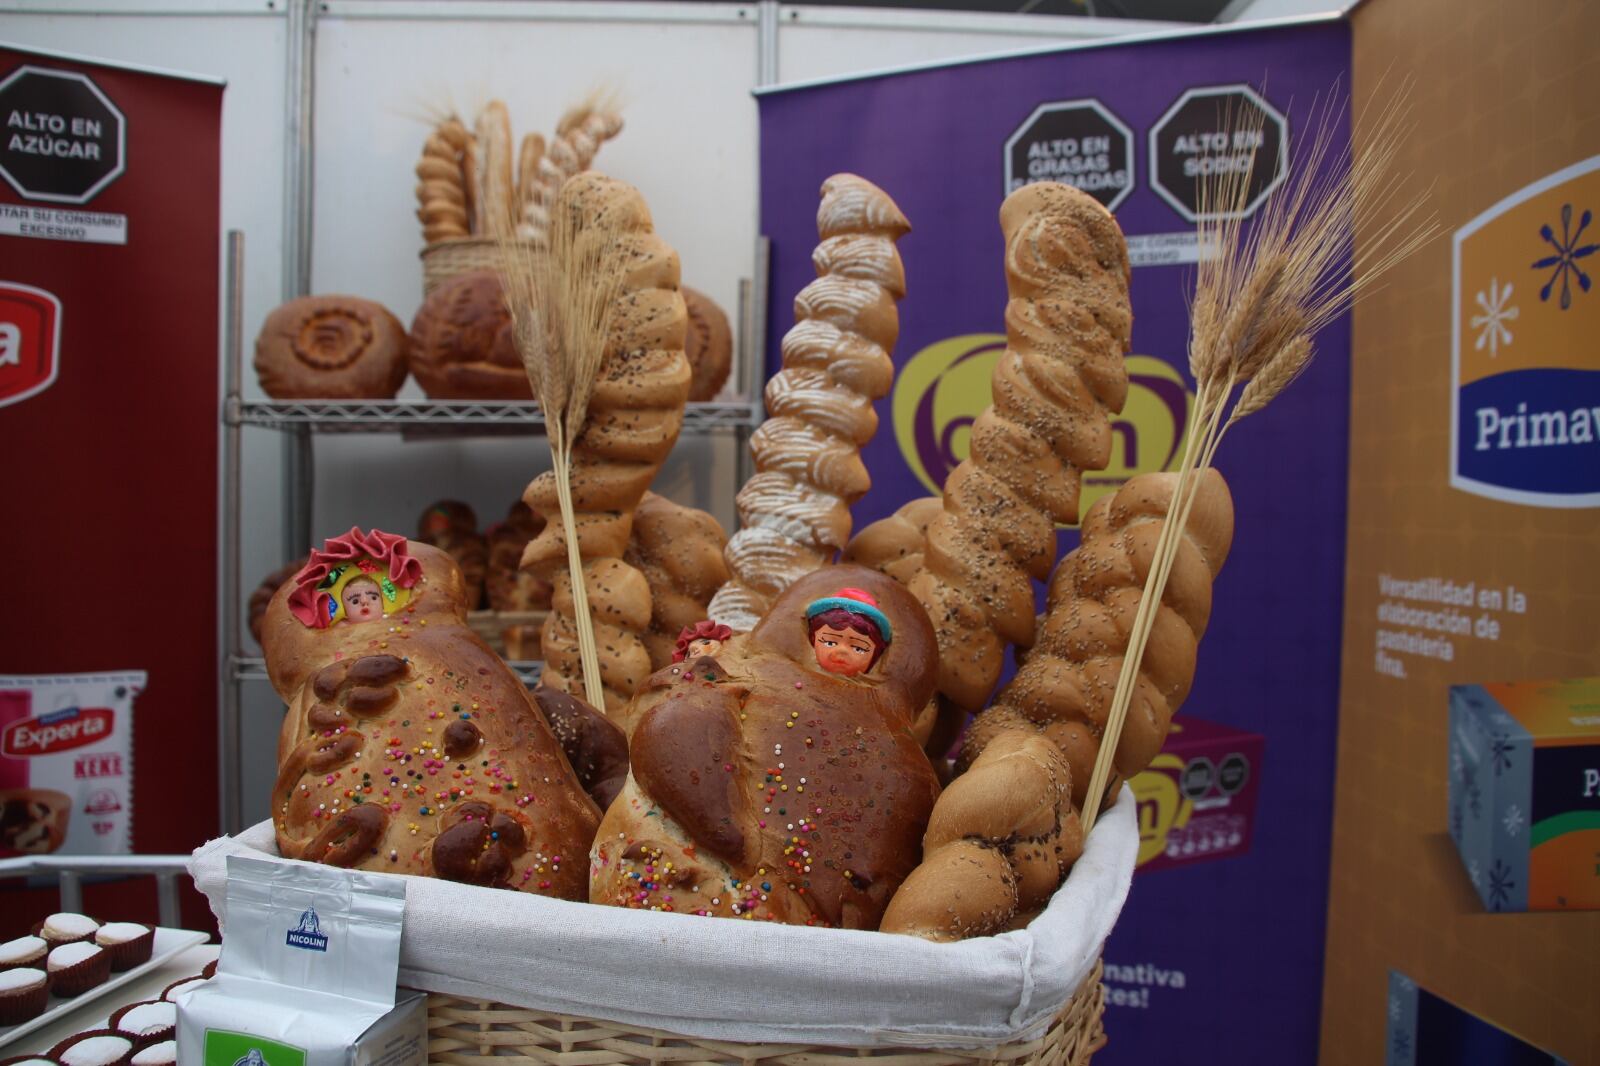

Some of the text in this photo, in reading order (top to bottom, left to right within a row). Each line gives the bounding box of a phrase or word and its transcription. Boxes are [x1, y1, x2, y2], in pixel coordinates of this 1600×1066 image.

[7, 109, 101, 136] ALTO EN
[8, 133, 100, 159] AZÚCAR
[1028, 135, 1110, 159] ALTO EN
[1173, 132, 1229, 154] ALTO
[1028, 153, 1110, 177] GRASAS
[33, 208, 51, 222] SU
[55, 211, 122, 228] CONSUMO
[20, 223, 86, 239] EXCESIVO
[1379, 574, 1527, 614] Versatilidad en la
[1378, 601, 1500, 640] elaboración de
[13, 716, 105, 749] Experta
[75, 757, 122, 778] KEKE
[289, 934, 325, 948] NICOLINI
[1103, 963, 1186, 989] nativa
